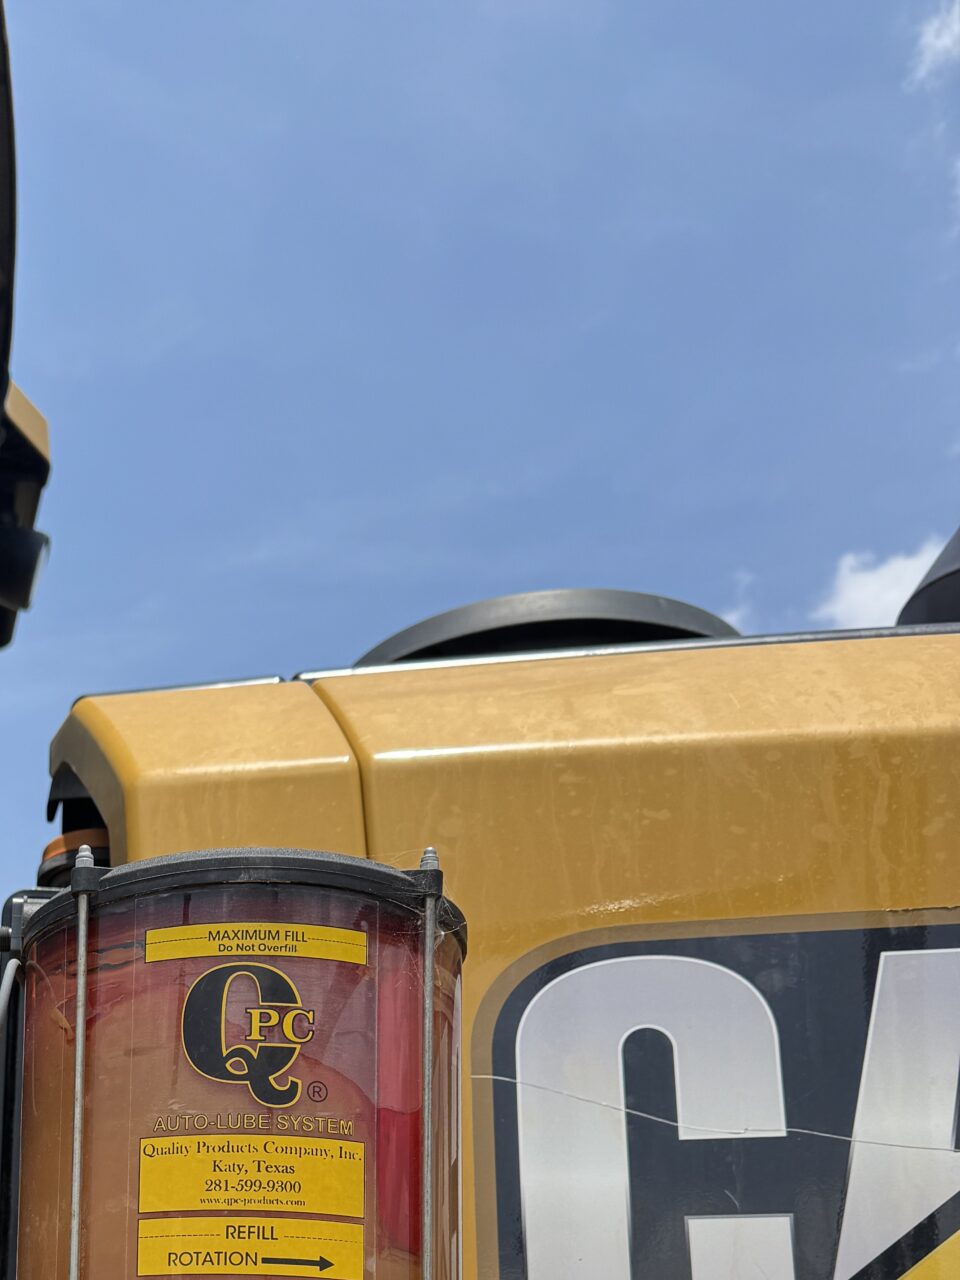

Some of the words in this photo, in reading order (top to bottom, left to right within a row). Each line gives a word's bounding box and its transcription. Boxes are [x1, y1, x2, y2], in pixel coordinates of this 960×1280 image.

[208, 930, 280, 942] MAXIMUM
[284, 931, 308, 943] FILL
[218, 944, 233, 952] Do
[236, 943, 255, 952] Not
[258, 943, 298, 953] Overfill
[153, 1113, 271, 1132] AUTO-LUBE
[277, 1114, 354, 1136] SYSTEM
[142, 1141, 190, 1157] Quality
[196, 1141, 259, 1154] Products
[263, 1141, 334, 1160] Company,
[339, 1146, 363, 1161] Inc.
[212, 1160, 249, 1176] Katy,
[252, 1160, 296, 1174] Texas
[205, 1179, 302, 1193] 281-599-9300
[200, 1196, 306, 1207] www.qpc-products.com
[225, 1225, 279, 1241] REFILL
[167, 1251, 258, 1267] ROTATION
